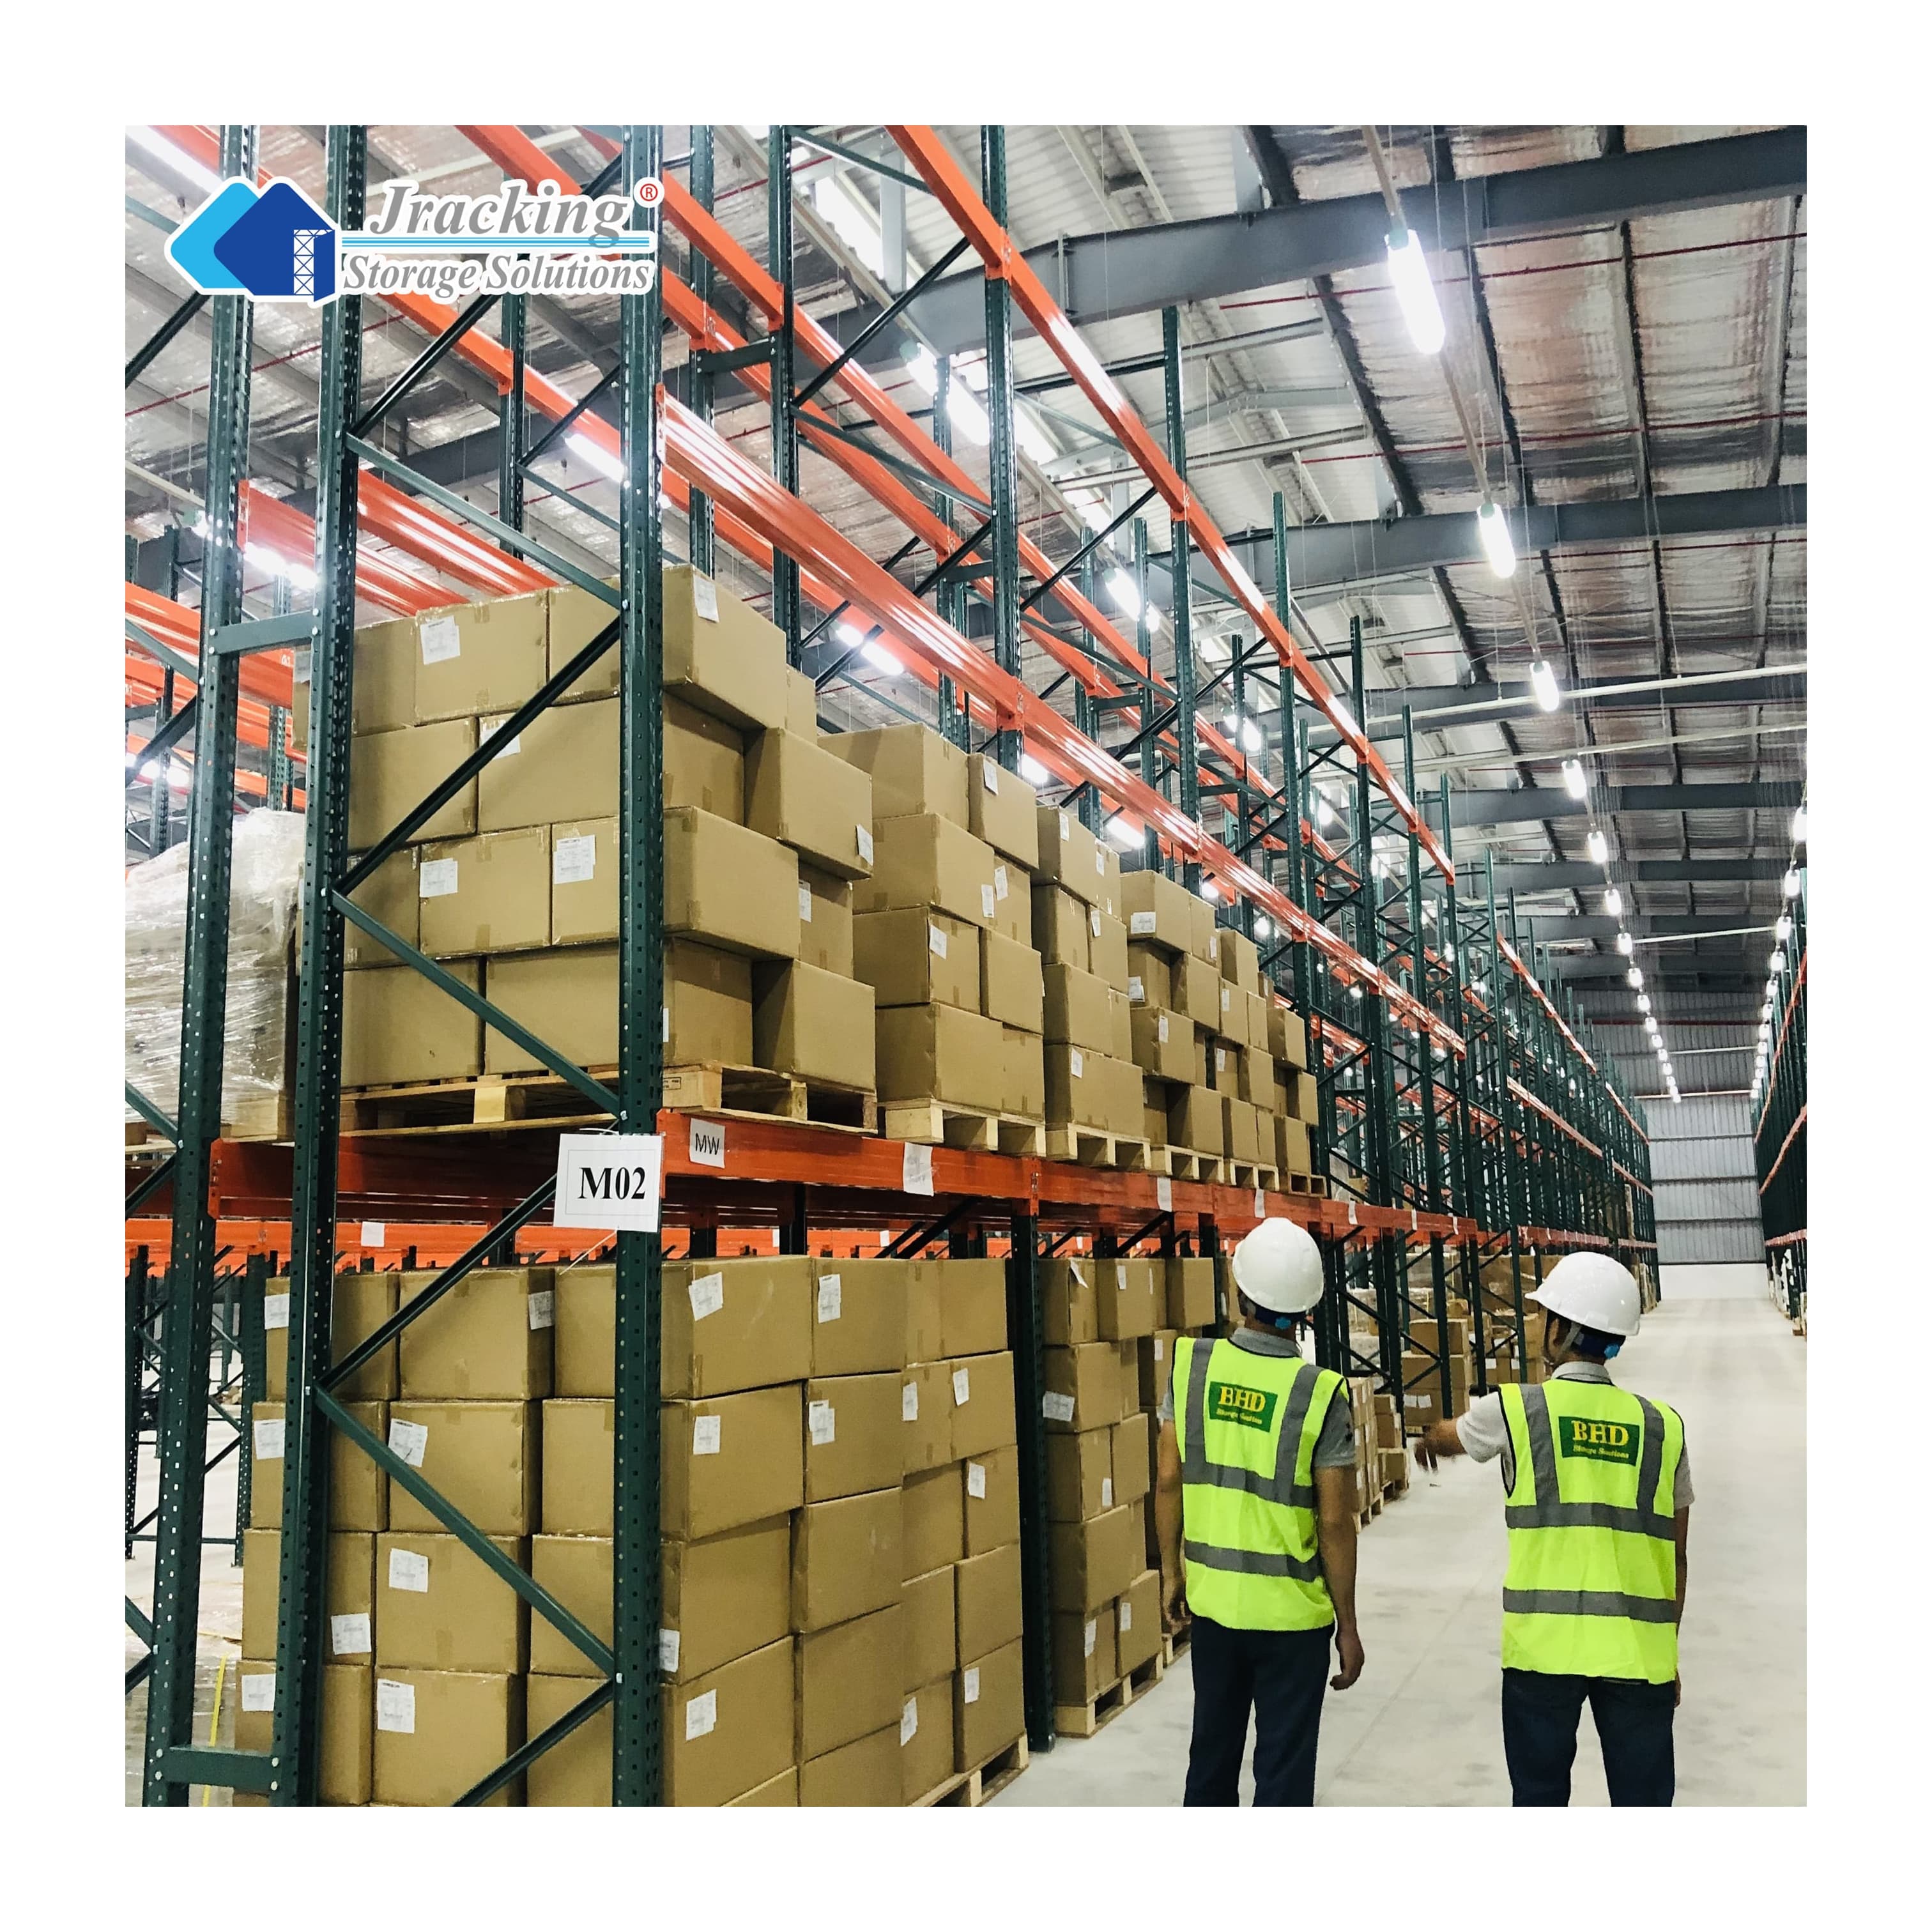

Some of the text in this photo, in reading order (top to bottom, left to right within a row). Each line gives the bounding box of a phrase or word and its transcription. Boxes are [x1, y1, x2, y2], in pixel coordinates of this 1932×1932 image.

[694, 1132, 721, 1156] MW
[578, 1166, 646, 1200] M02
[1218, 1385, 1266, 1413] BHD
[1570, 1420, 1630, 1446] BHD
